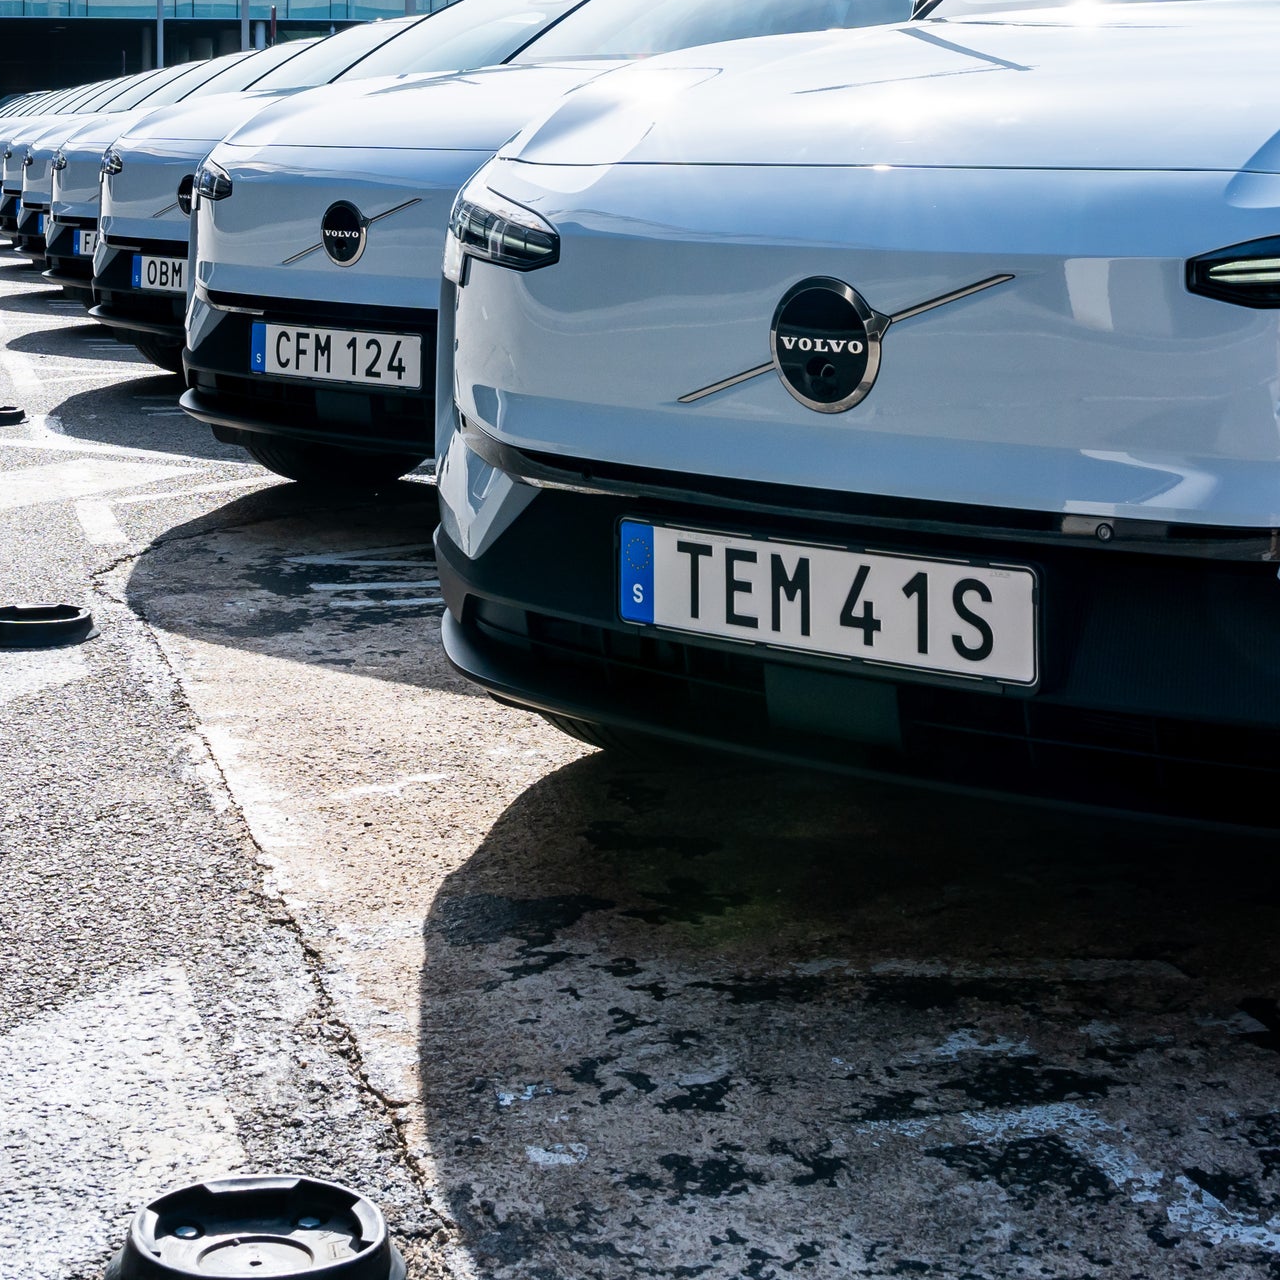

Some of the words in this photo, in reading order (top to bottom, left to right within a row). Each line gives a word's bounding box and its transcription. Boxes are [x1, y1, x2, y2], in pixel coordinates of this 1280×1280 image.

[323, 229, 360, 239] VOLVO
[146, 260, 184, 288] OBM
[275, 331, 332, 373] CFM
[346, 336, 407, 380] 124
[780, 335, 864, 355] VOLVO
[256, 352, 262, 364] S
[632, 582, 644, 605] S
[676, 540, 811, 637] TEM
[839, 565, 994, 662] 41S
